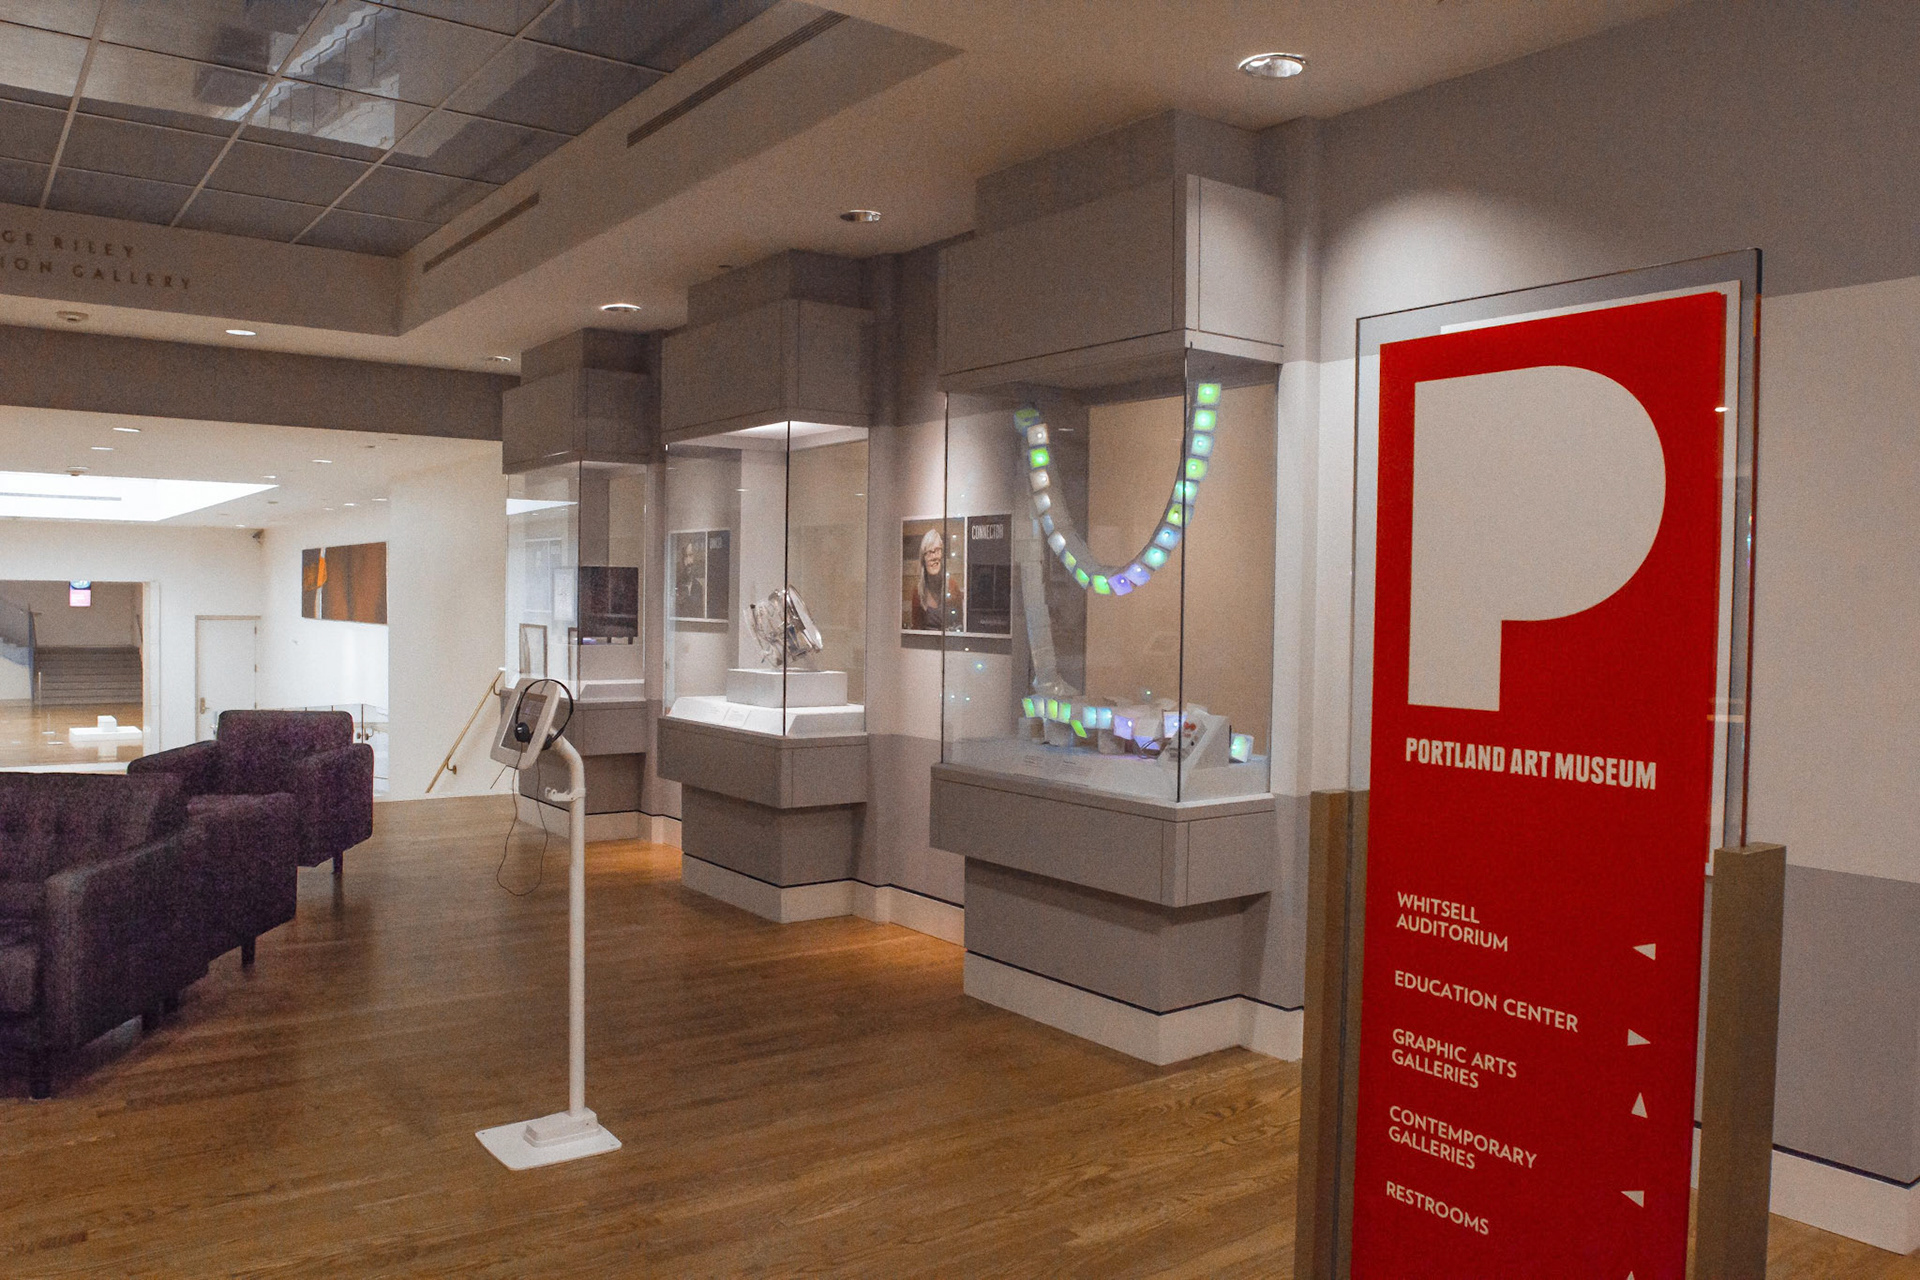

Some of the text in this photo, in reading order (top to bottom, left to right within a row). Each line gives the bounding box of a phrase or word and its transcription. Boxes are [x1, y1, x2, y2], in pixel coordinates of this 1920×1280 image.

[53, 236, 133, 258] RILEY
[72, 265, 190, 290] GALLERY
[1407, 365, 1666, 712] P
[1405, 737, 1657, 790] PORTLAND ART MUSEUM
[1397, 891, 1480, 924] WHITSELL
[1396, 913, 1509, 952] AUDITORIUM
[1394, 970, 1579, 1033] EDUCATION CENTER
[1391, 1048, 1479, 1089] GALLERIES
[1392, 1028, 1518, 1079] GRAPHIC ARTS
[1388, 1126, 1476, 1170] GALLERIES
[1389, 1105, 1538, 1169] CONTEMPORARY
[1386, 1180, 1490, 1236] RESTROOMS
